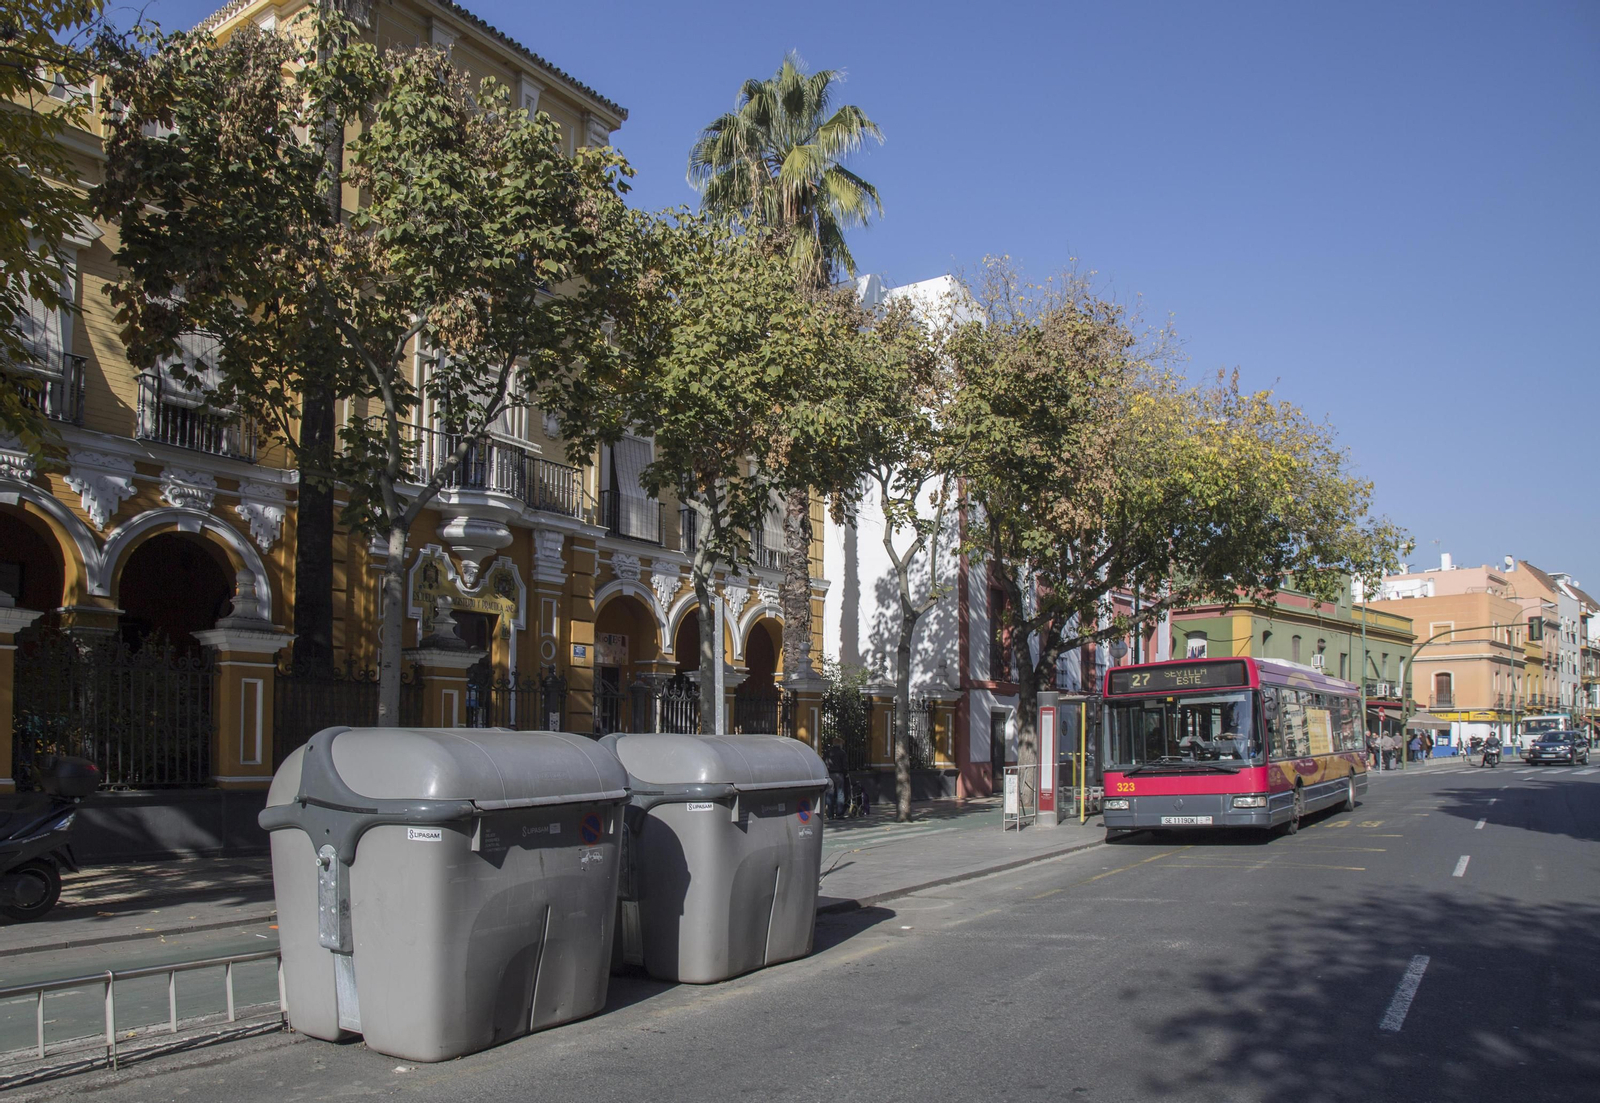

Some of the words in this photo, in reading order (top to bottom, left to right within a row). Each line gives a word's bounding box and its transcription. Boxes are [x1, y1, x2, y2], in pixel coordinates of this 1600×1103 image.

[1163, 668, 1207, 678] SEVILLA
[1131, 673, 1151, 686] 27
[1176, 675, 1202, 685] ESTE
[1116, 782, 1136, 792] 323
[414, 832, 440, 840] LIPASAM
